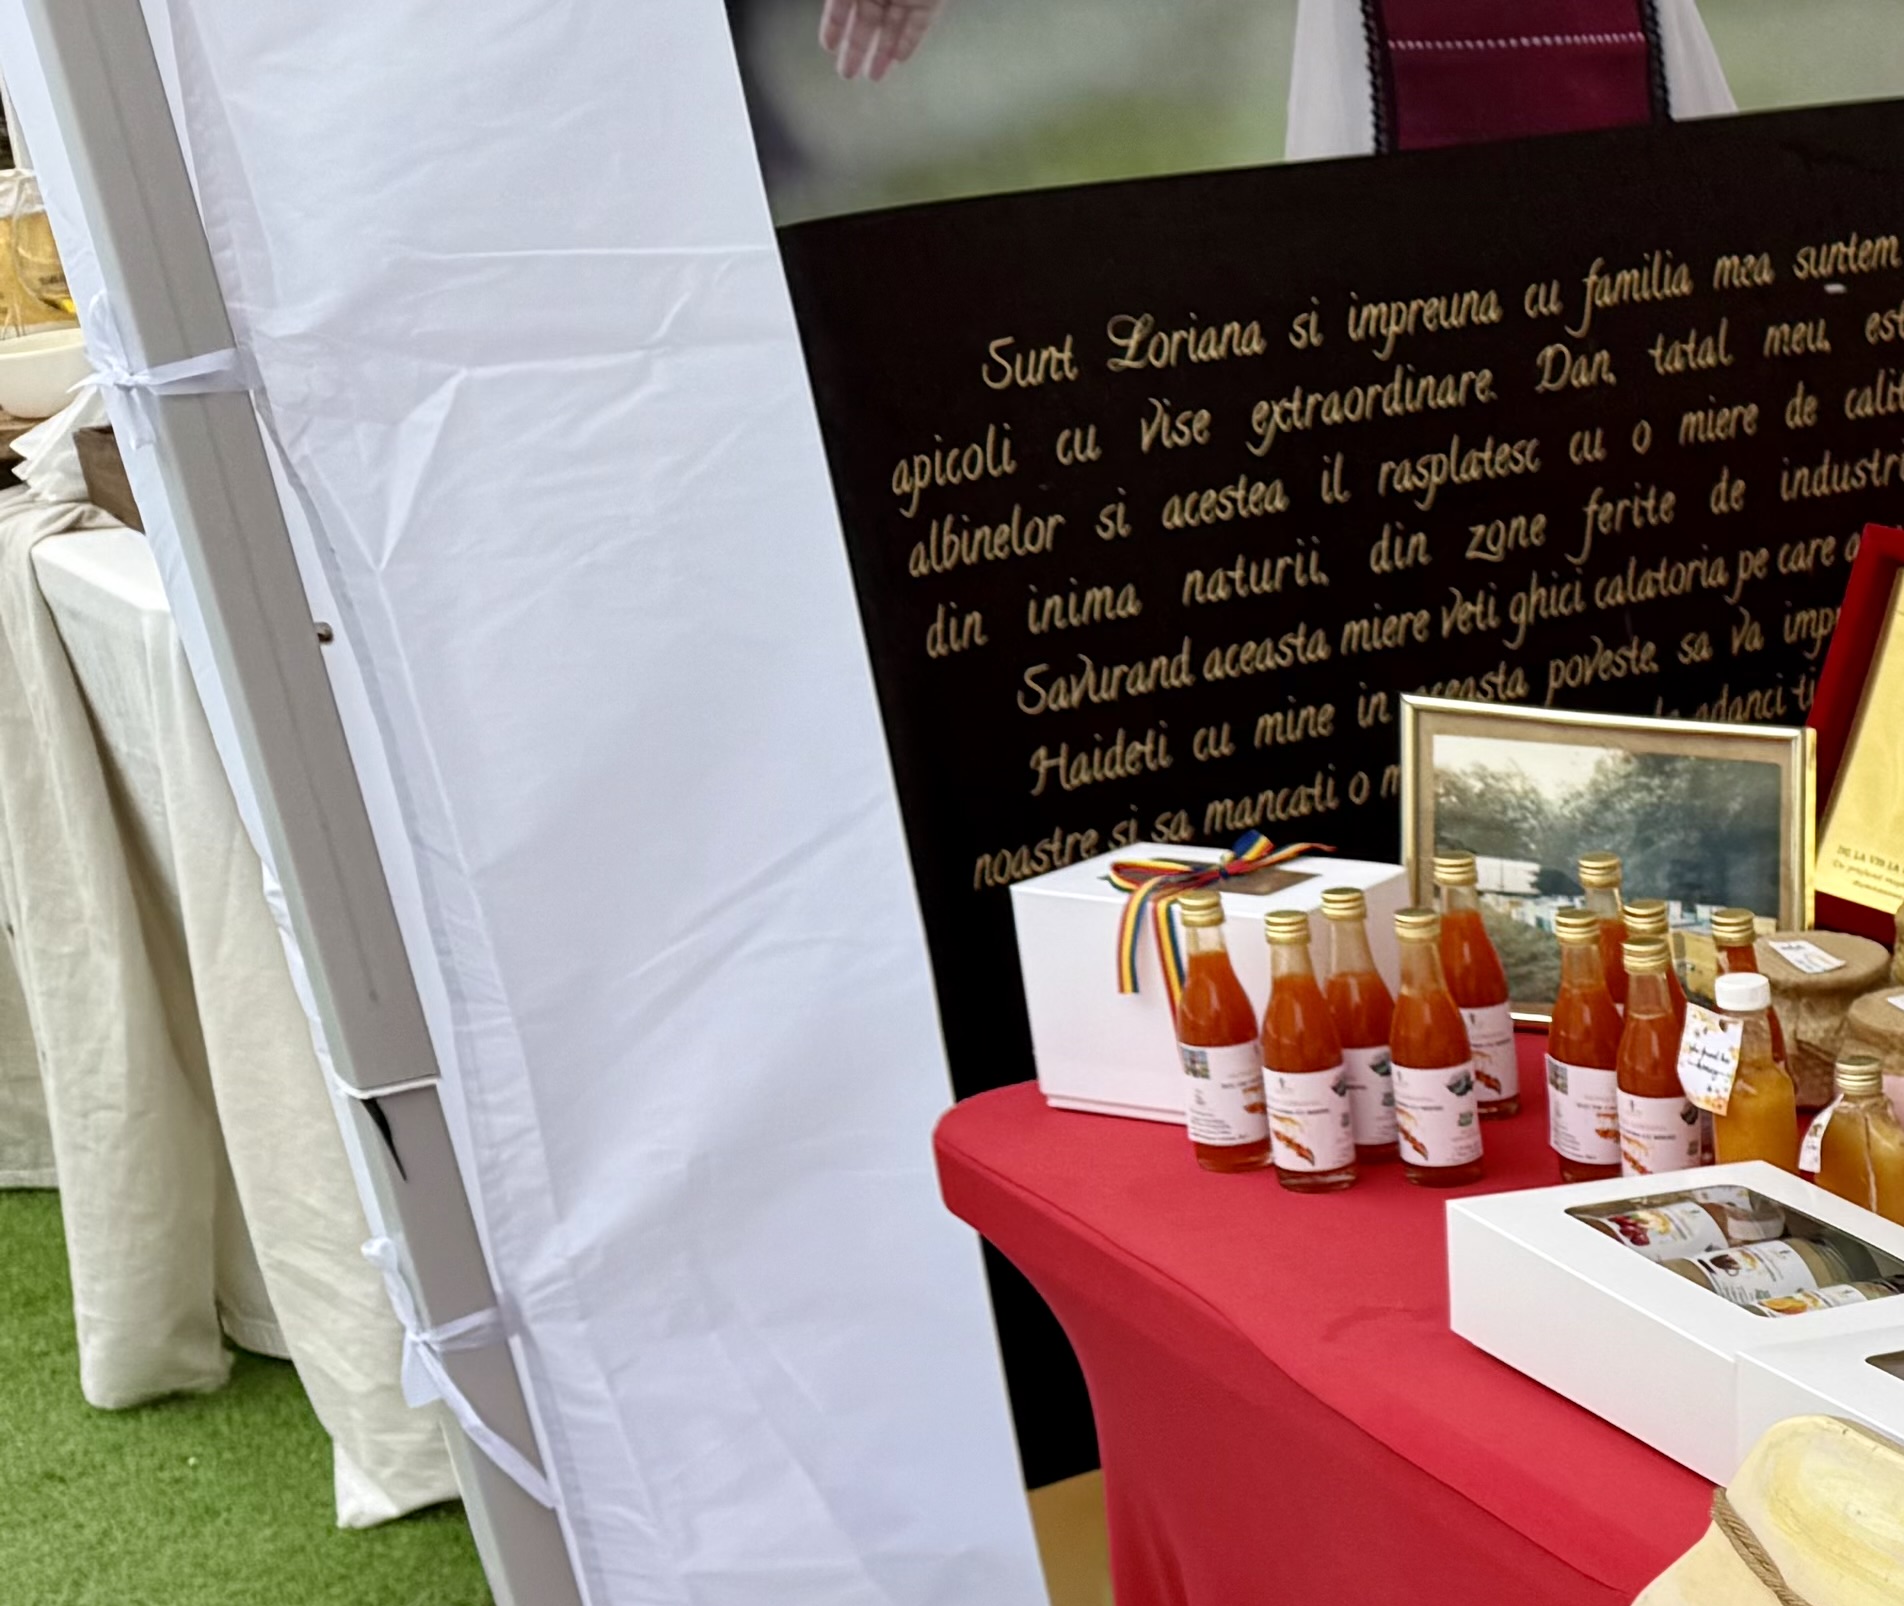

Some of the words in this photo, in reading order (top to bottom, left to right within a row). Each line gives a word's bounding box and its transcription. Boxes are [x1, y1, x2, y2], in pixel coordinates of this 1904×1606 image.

[982, 335, 1078, 389] Sunt
[1107, 313, 1266, 371] Loriana
[1289, 296, 1324, 347] si
[1348, 289, 1500, 360] impreuna
[1524, 279, 1563, 318] cu
[1566, 249, 1692, 338] familia
[1714, 255, 1774, 291] mea
[1794, 230, 1900, 282] suntem
[892, 423, 1016, 518] apicoli
[1057, 423, 1101, 465] cu
[1648, 318, 1732, 375] tatal
[908, 504, 1066, 578] albinelor
[1096, 488, 1131, 540] si
[1162, 475, 1288, 530] acestea
[1321, 454, 1350, 504] il
[1378, 434, 1540, 510] rasplatesc
[1569, 427, 1607, 464] cu
[1631, 419, 1652, 454] o
[1679, 400, 1758, 447] miere
[1785, 381, 1818, 429] de
[926, 603, 988, 658] din
[1027, 580, 1142, 635] inima
[1369, 521, 1431, 573] din
[1466, 515, 1547, 562] zone
[1574, 487, 1676, 563] ferite
[1710, 466, 1746, 516] de
[1017, 635, 1195, 715] Savurand
[1203, 624, 1331, 680] aceasta
[1340, 603, 1429, 653] miere
[1503, 566, 1587, 650] ghici
[1595, 543, 1729, 610] calatoria
[1730, 545, 1768, 604] pe
[1778, 535, 1837, 579] care
[1029, 718, 1173, 797] Haideti
[1192, 722, 1237, 764] cu
[1254, 696, 1336, 750] mine
[1356, 681, 1393, 730] in
[1679, 631, 1713, 665] sa
[973, 826, 1099, 891] noastre
[1108, 803, 1140, 849] si
[1151, 806, 1195, 845] sa
[1202, 763, 1340, 835] mancati
[1347, 768, 1371, 802] o
